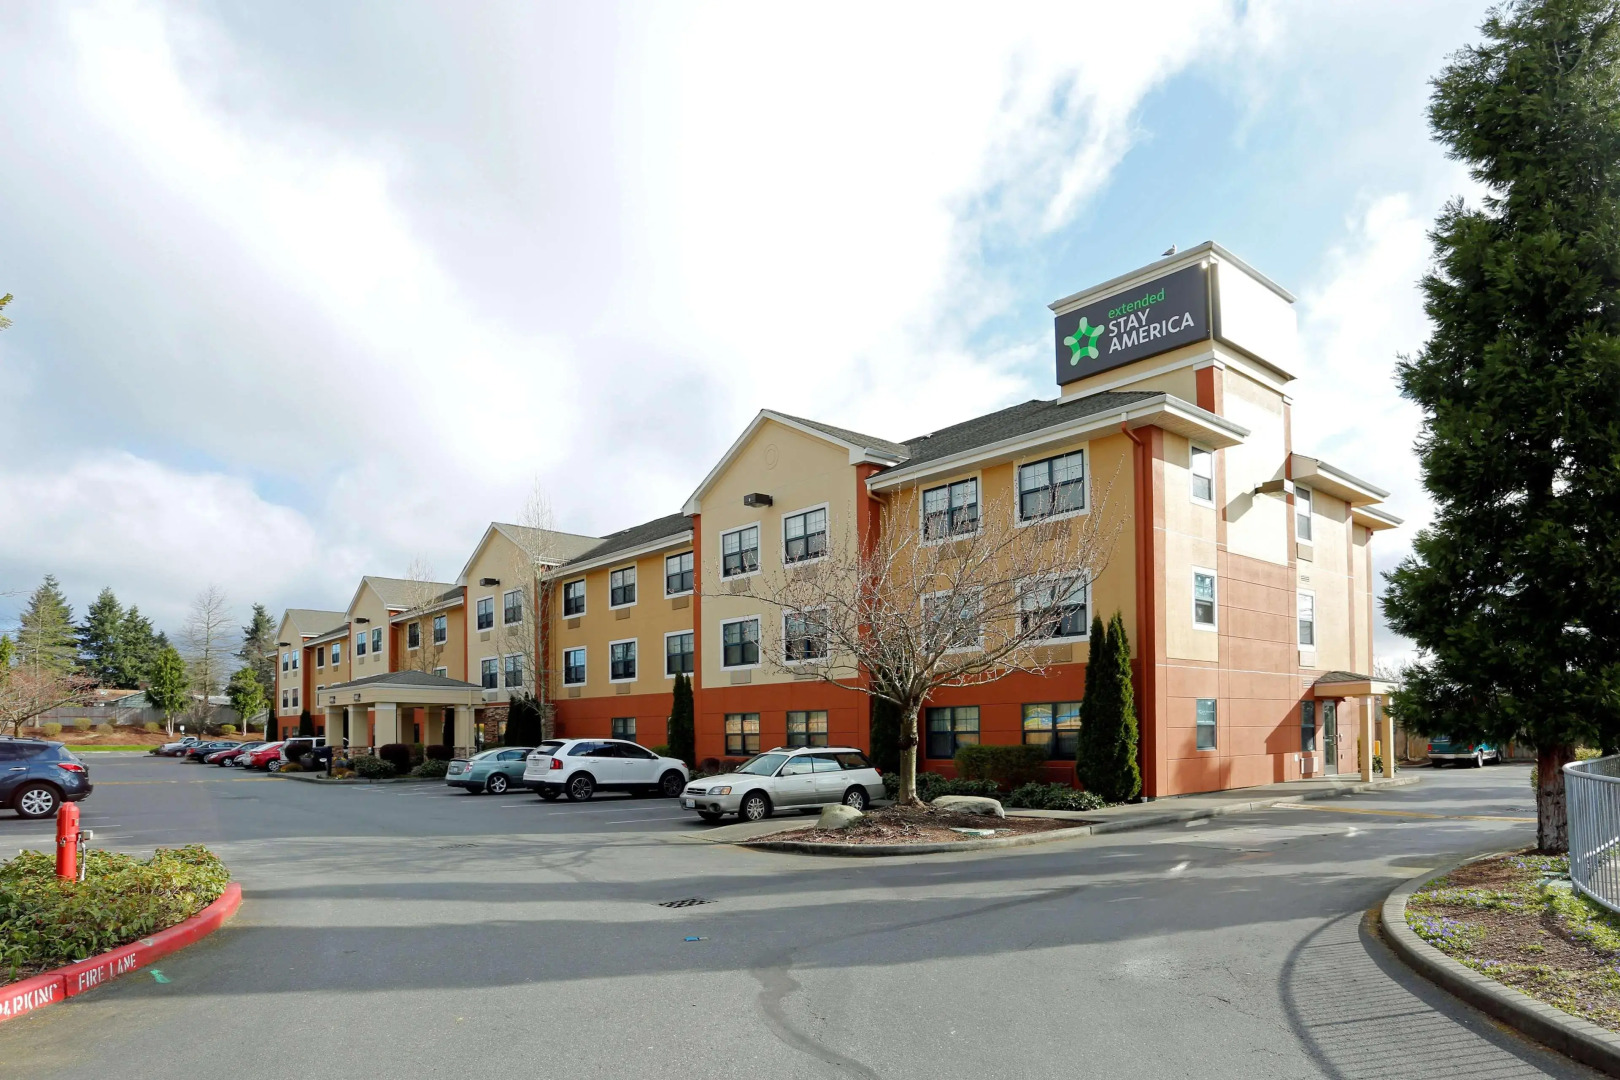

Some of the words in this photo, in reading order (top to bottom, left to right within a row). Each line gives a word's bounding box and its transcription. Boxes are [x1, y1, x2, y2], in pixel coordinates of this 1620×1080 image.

[1108, 288, 1166, 319] extended
[1108, 308, 1150, 337] STAY
[1109, 312, 1195, 354] AMERICA
[78, 965, 105, 991] FIRE
[109, 952, 137, 981] LANE
